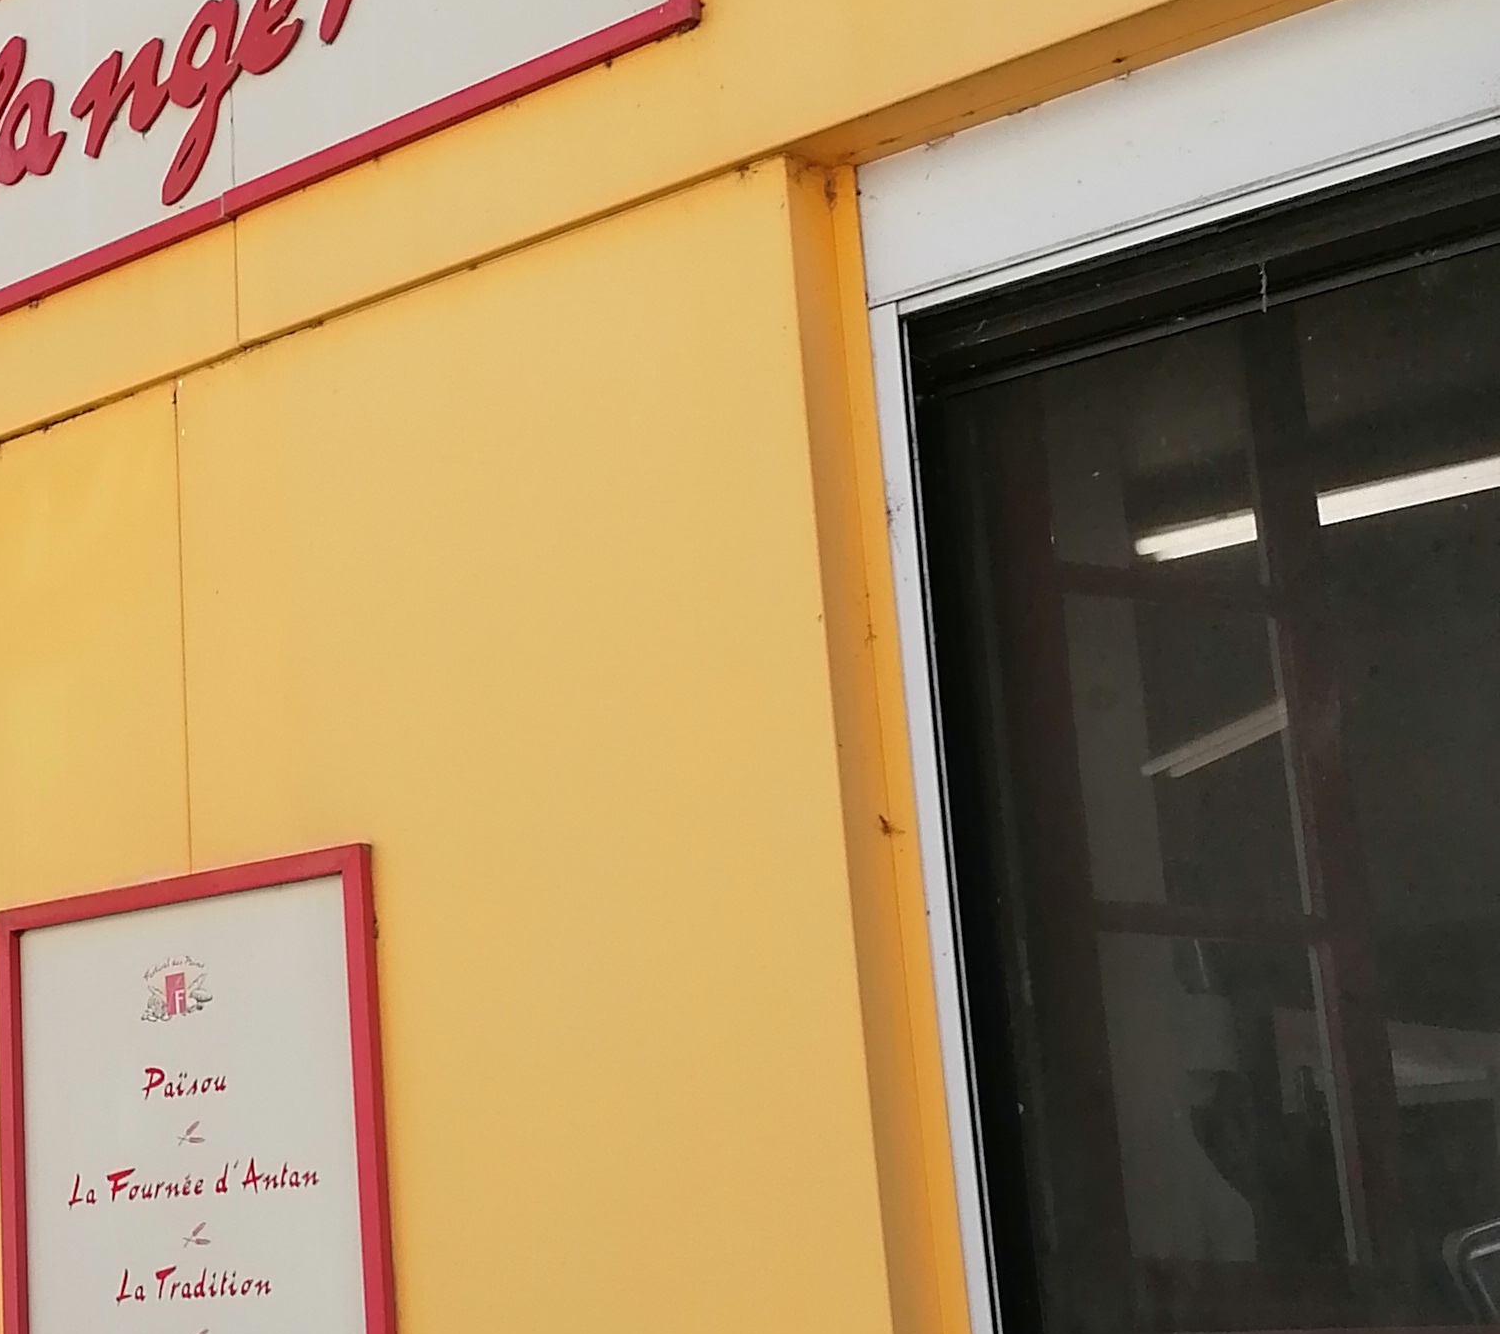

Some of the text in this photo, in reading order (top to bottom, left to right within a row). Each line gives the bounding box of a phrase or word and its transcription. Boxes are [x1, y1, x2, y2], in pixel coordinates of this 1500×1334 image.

[141, 1067, 227, 1100] Païsou
[68, 1173, 97, 1210] La
[106, 1168, 204, 1202] Fournée
[116, 1266, 272, 1306] La Tradition
